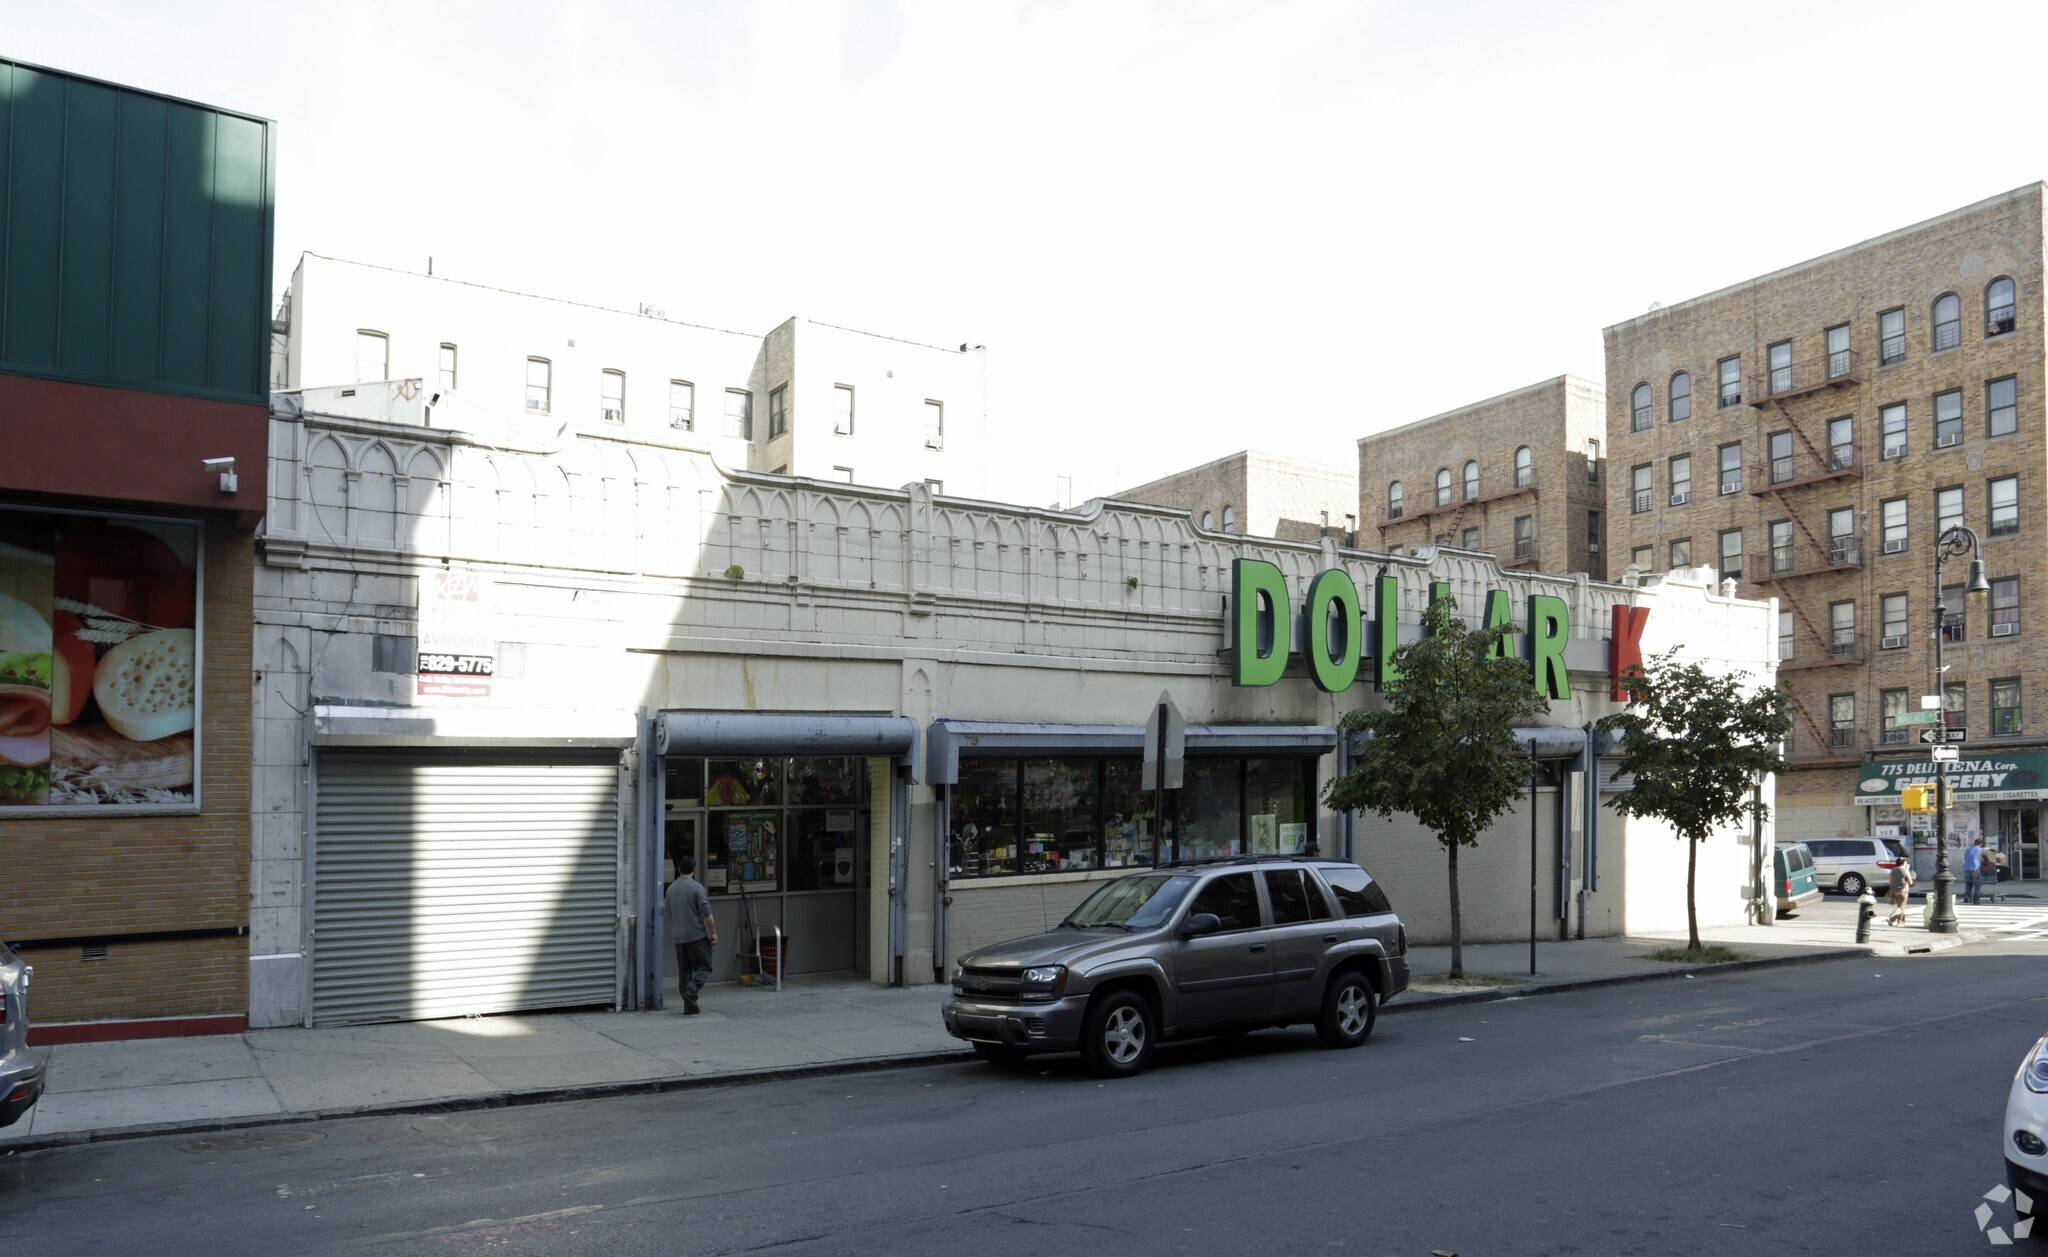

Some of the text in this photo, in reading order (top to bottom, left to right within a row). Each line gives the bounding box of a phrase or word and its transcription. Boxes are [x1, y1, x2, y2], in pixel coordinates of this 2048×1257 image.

[423, 633, 489, 648] AVAILABLE
[1881, 764, 1903, 776] 775
[1995, 762, 2018, 771] Corp.
[2002, 791, 2039, 799] CIGARETTES
[1282, 834, 1296, 846] KEYS
